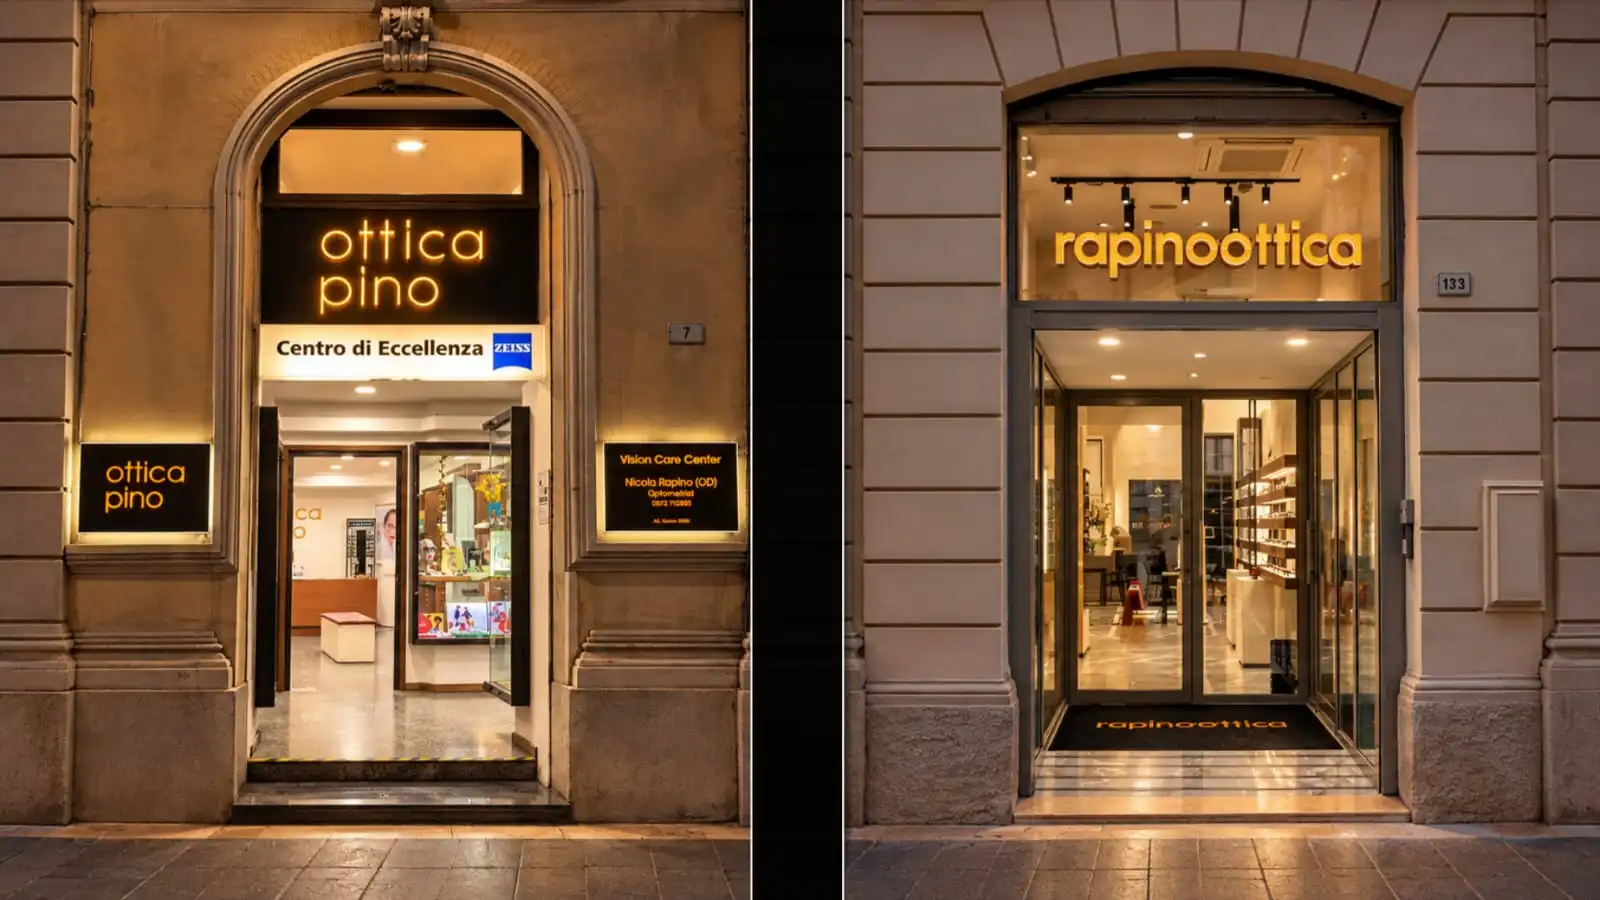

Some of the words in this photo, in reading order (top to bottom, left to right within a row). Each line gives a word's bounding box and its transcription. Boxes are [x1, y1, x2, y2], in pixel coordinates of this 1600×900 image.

[320, 219, 484, 262] ottica
[1055, 220, 1363, 278] rapinoottica
[319, 266, 440, 316] pino
[1442, 277, 1466, 291] 133
[682, 326, 691, 339] 7
[276, 340, 346, 356] Centro
[352, 339, 371, 356] di
[378, 339, 484, 356] Eccellenza
[494, 342, 532, 353] ZEISS
[620, 454, 652, 465] Vision
[654, 454, 681, 465] Care
[683, 454, 721, 465] Center
[105, 461, 186, 484] ottica
[624, 477, 657, 487] Nicola
[658, 477, 693, 489] Rapino
[104, 486, 164, 513] pino
[1095, 719, 1288, 730] rapinoottica
